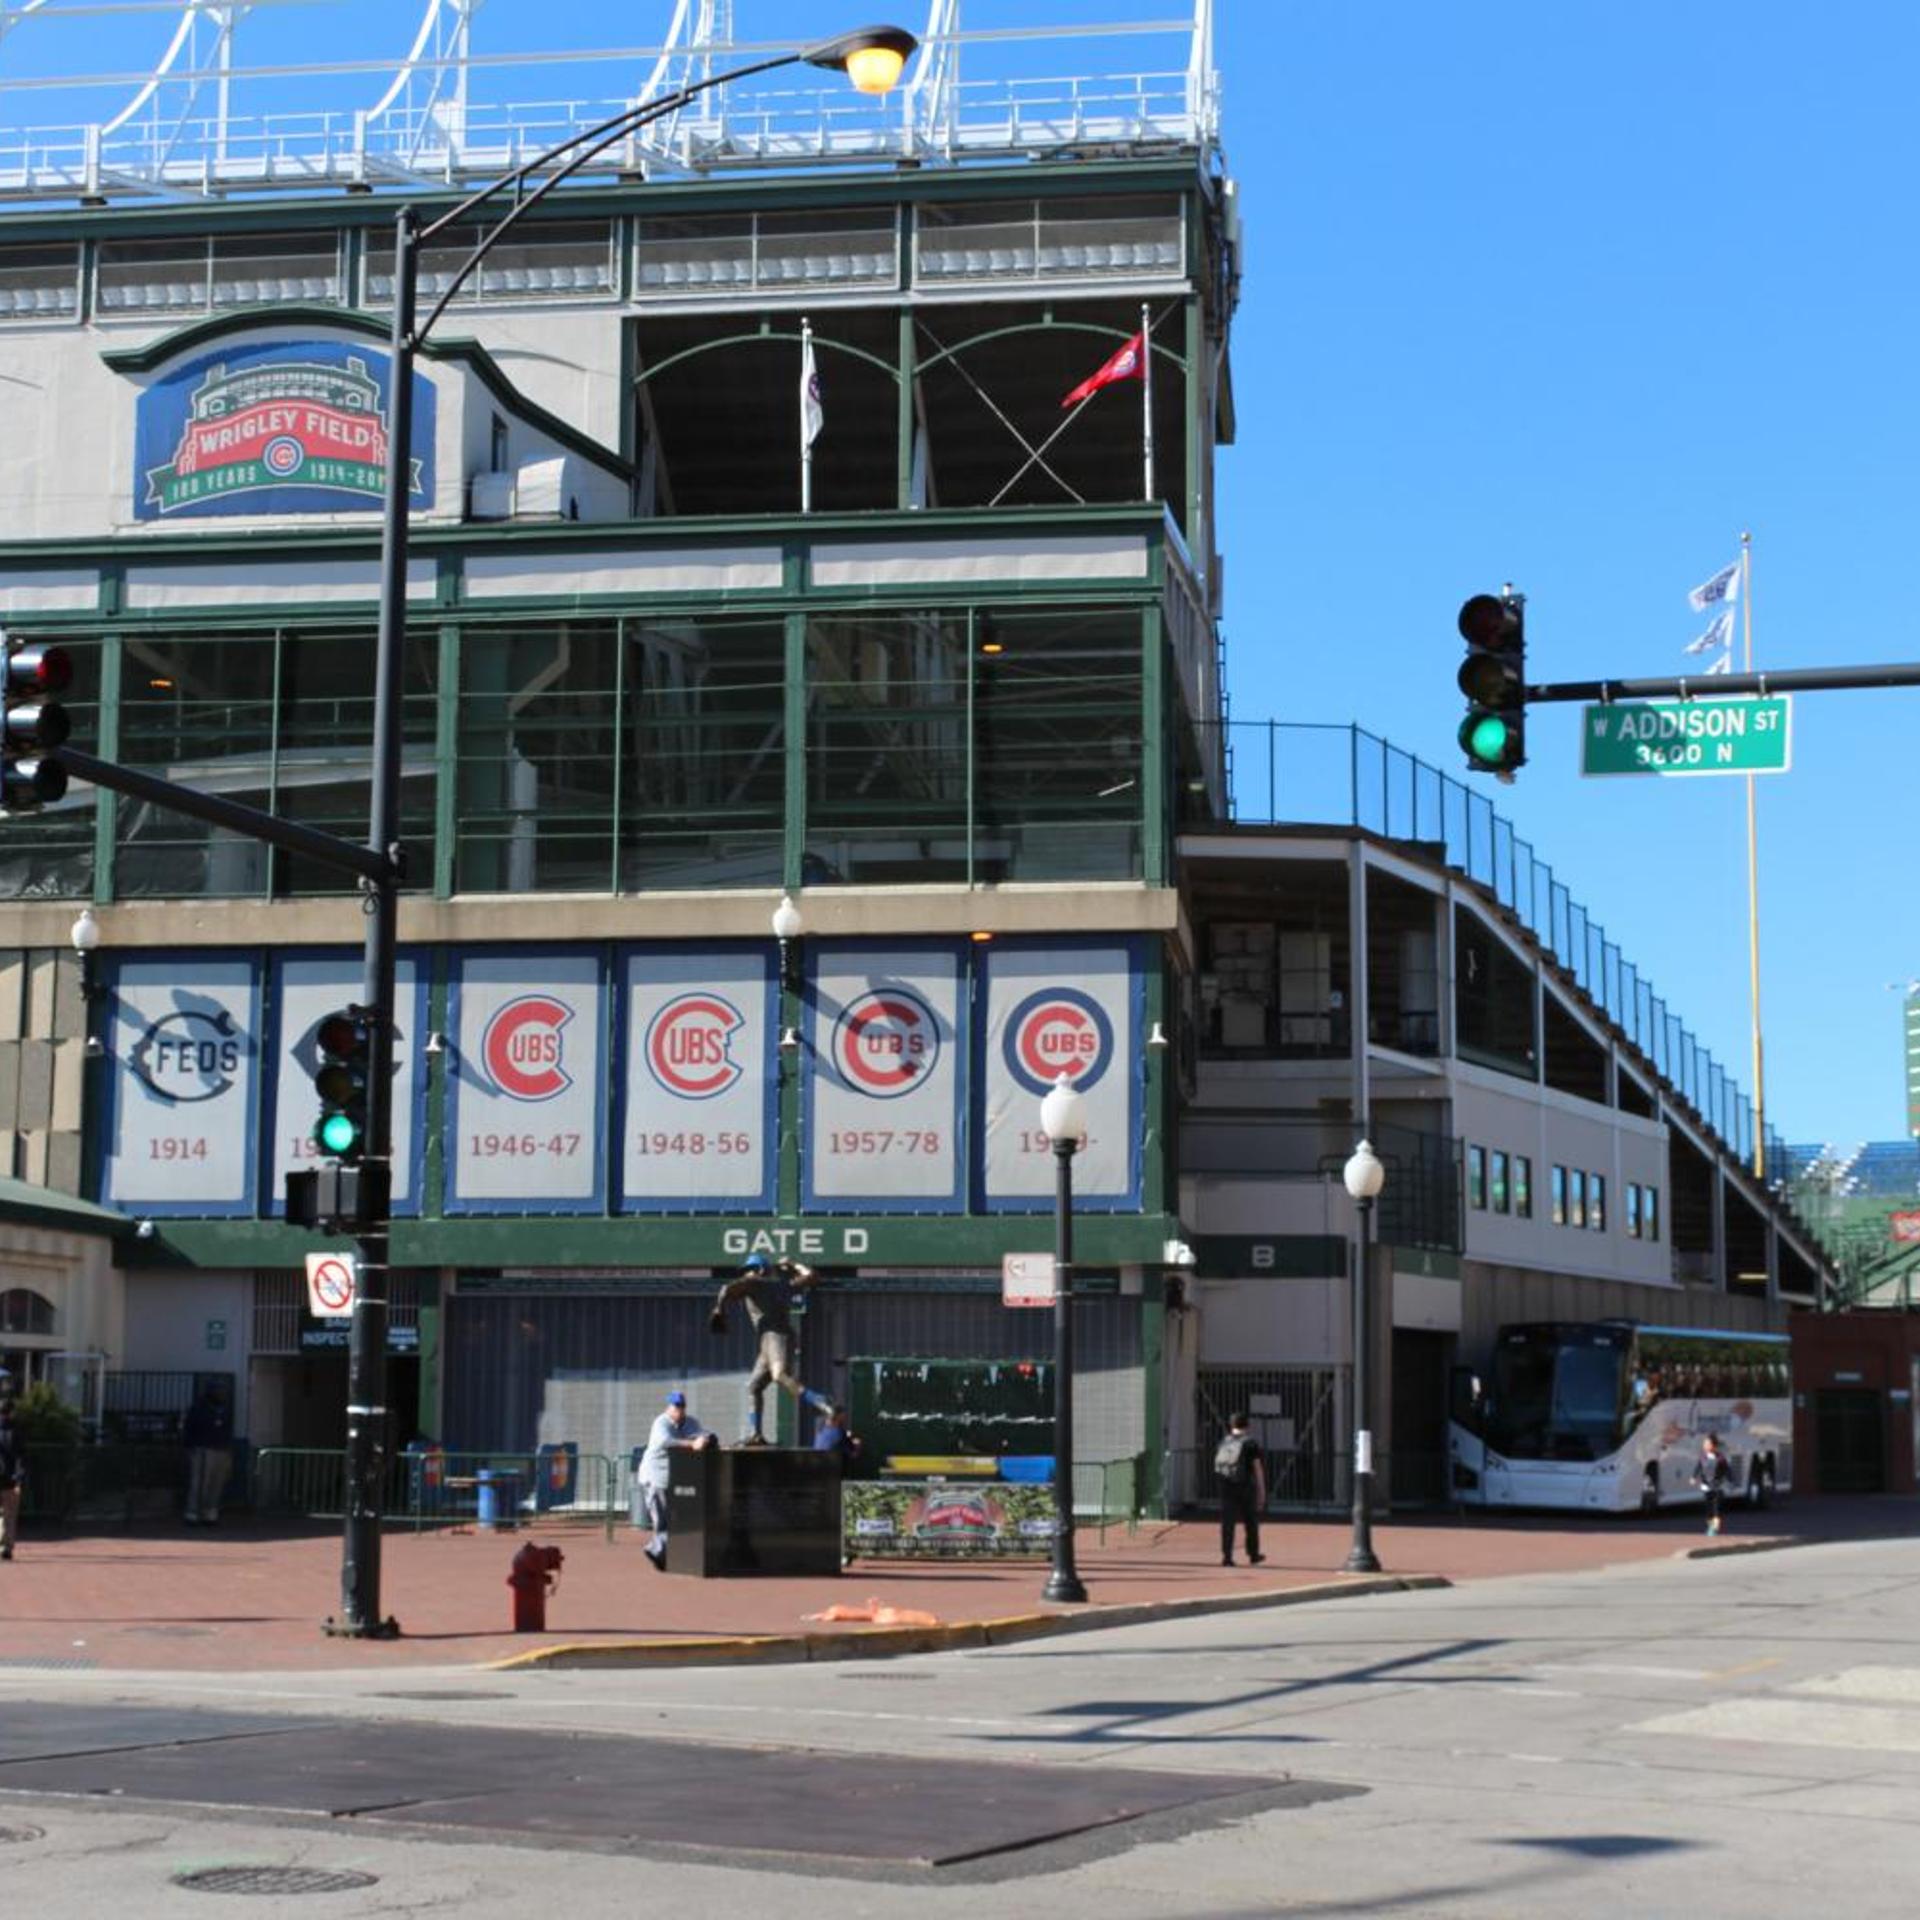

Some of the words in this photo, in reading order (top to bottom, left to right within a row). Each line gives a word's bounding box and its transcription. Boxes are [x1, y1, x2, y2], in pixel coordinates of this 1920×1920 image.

[201, 408, 298, 454] WRIGLEY
[306, 412, 370, 447] FIELD
[206, 466, 256, 488] YEARS
[1592, 717, 1608, 738] W
[1617, 708, 1746, 741] ADDISON
[1754, 709, 1779, 731] ST
[1717, 742, 1734, 763] N
[156, 1041, 239, 1073] FEDS
[149, 1138, 208, 1160] 1914
[470, 1135, 581, 1158] 1946-47
[637, 1132, 751, 1155] 1948-56
[829, 1132, 940, 1154] 1957-78
[1019, 1131, 1099, 1154] 199-
[722, 1228, 825, 1254] GATE
[843, 1229, 869, 1254] D
[1251, 1245, 1276, 1268] B
